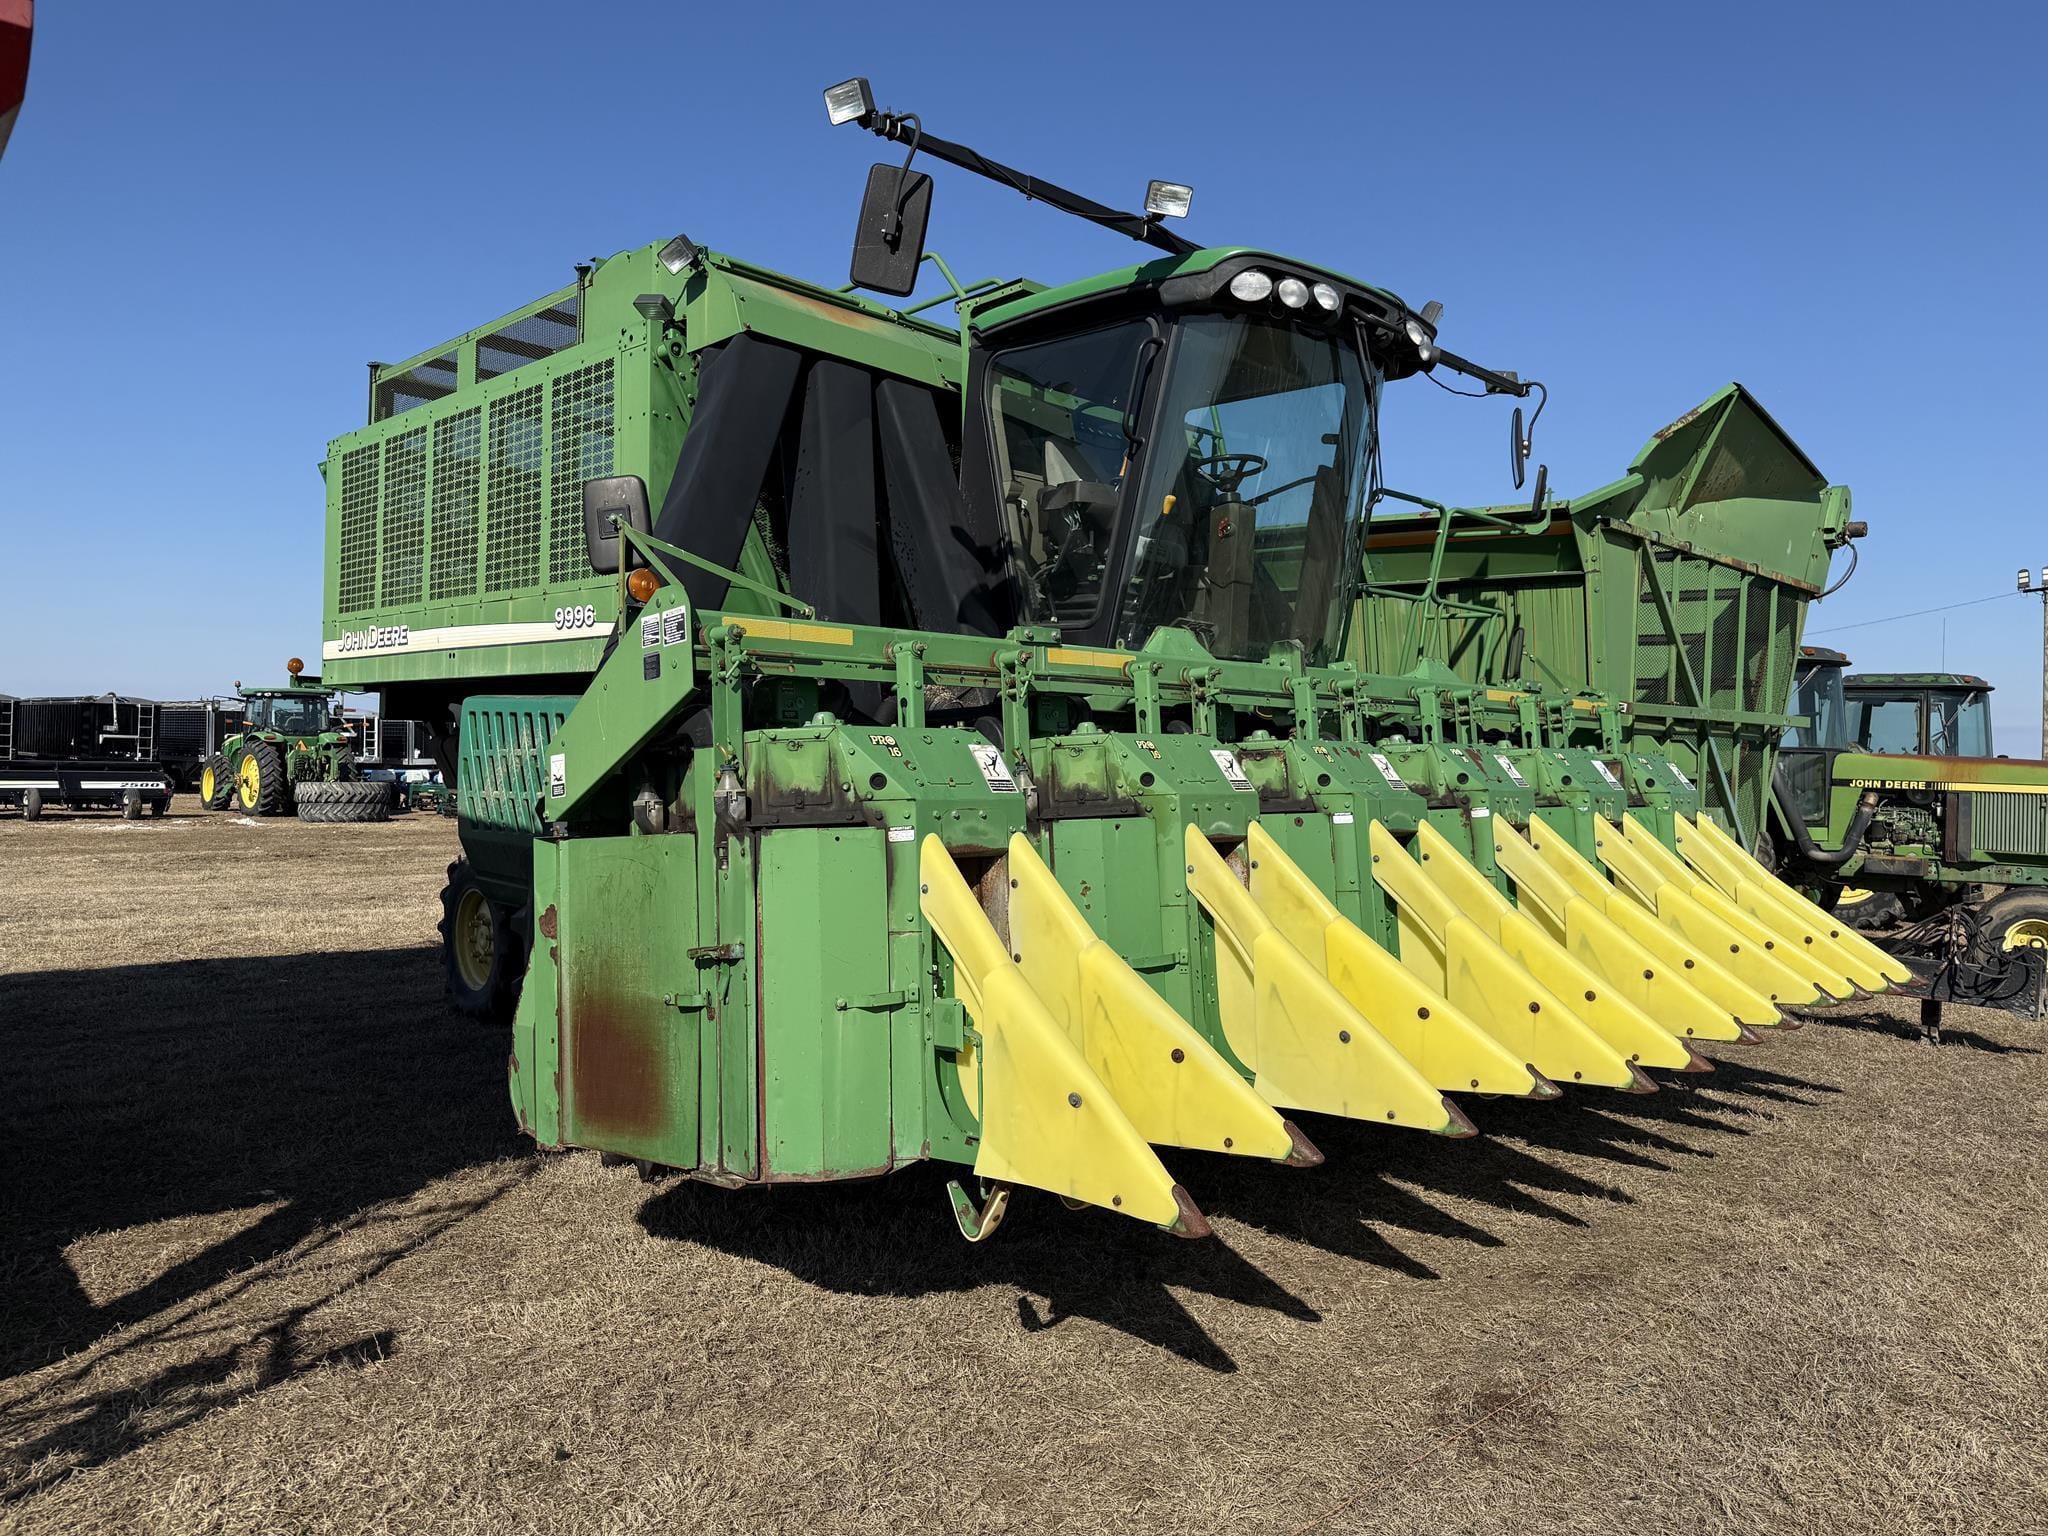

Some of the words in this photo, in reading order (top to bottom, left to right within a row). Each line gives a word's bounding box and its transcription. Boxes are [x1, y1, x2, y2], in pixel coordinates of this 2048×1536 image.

[554, 604, 595, 631] 9996
[338, 628, 368, 652] JOHN
[368, 624, 409, 649] DEERE
[869, 734, 896, 746] PRO
[888, 746, 902, 757] 16
[1849, 779, 1881, 788] JOHN
[1885, 781, 1926, 790] DEERE
